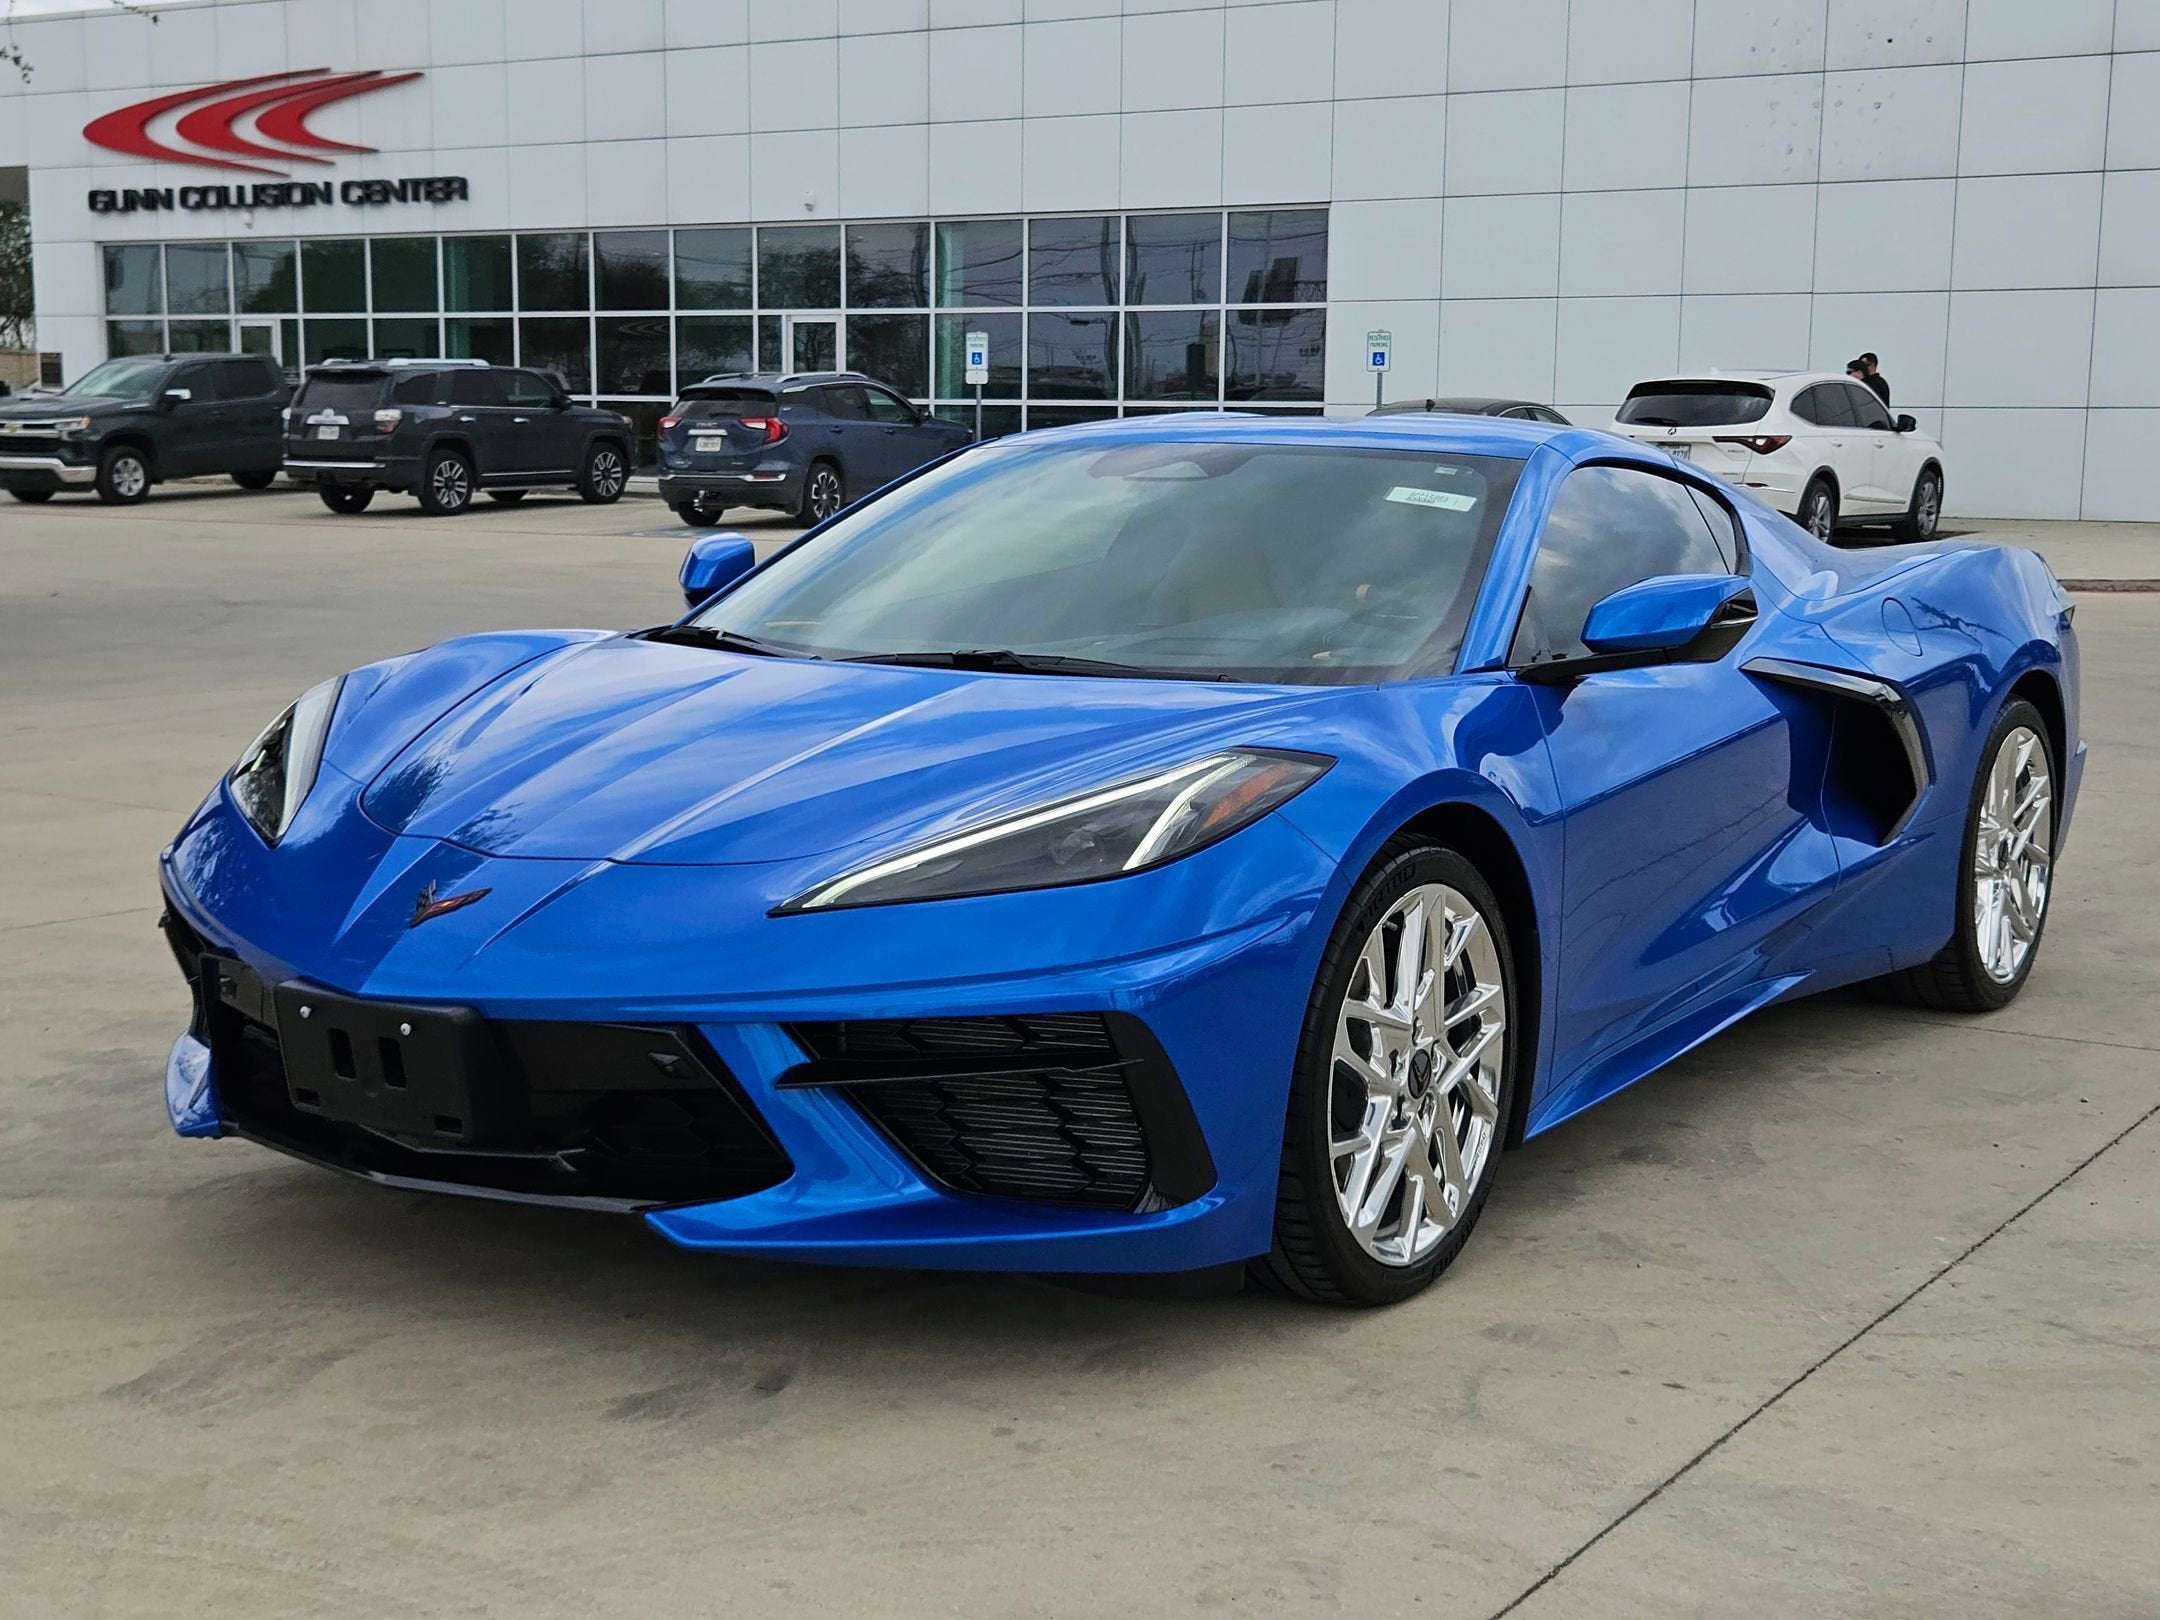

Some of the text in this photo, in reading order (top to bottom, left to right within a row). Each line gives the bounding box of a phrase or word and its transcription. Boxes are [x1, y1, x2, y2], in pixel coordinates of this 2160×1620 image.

[88, 176, 469, 214] GUNN COLLISION CENTER
